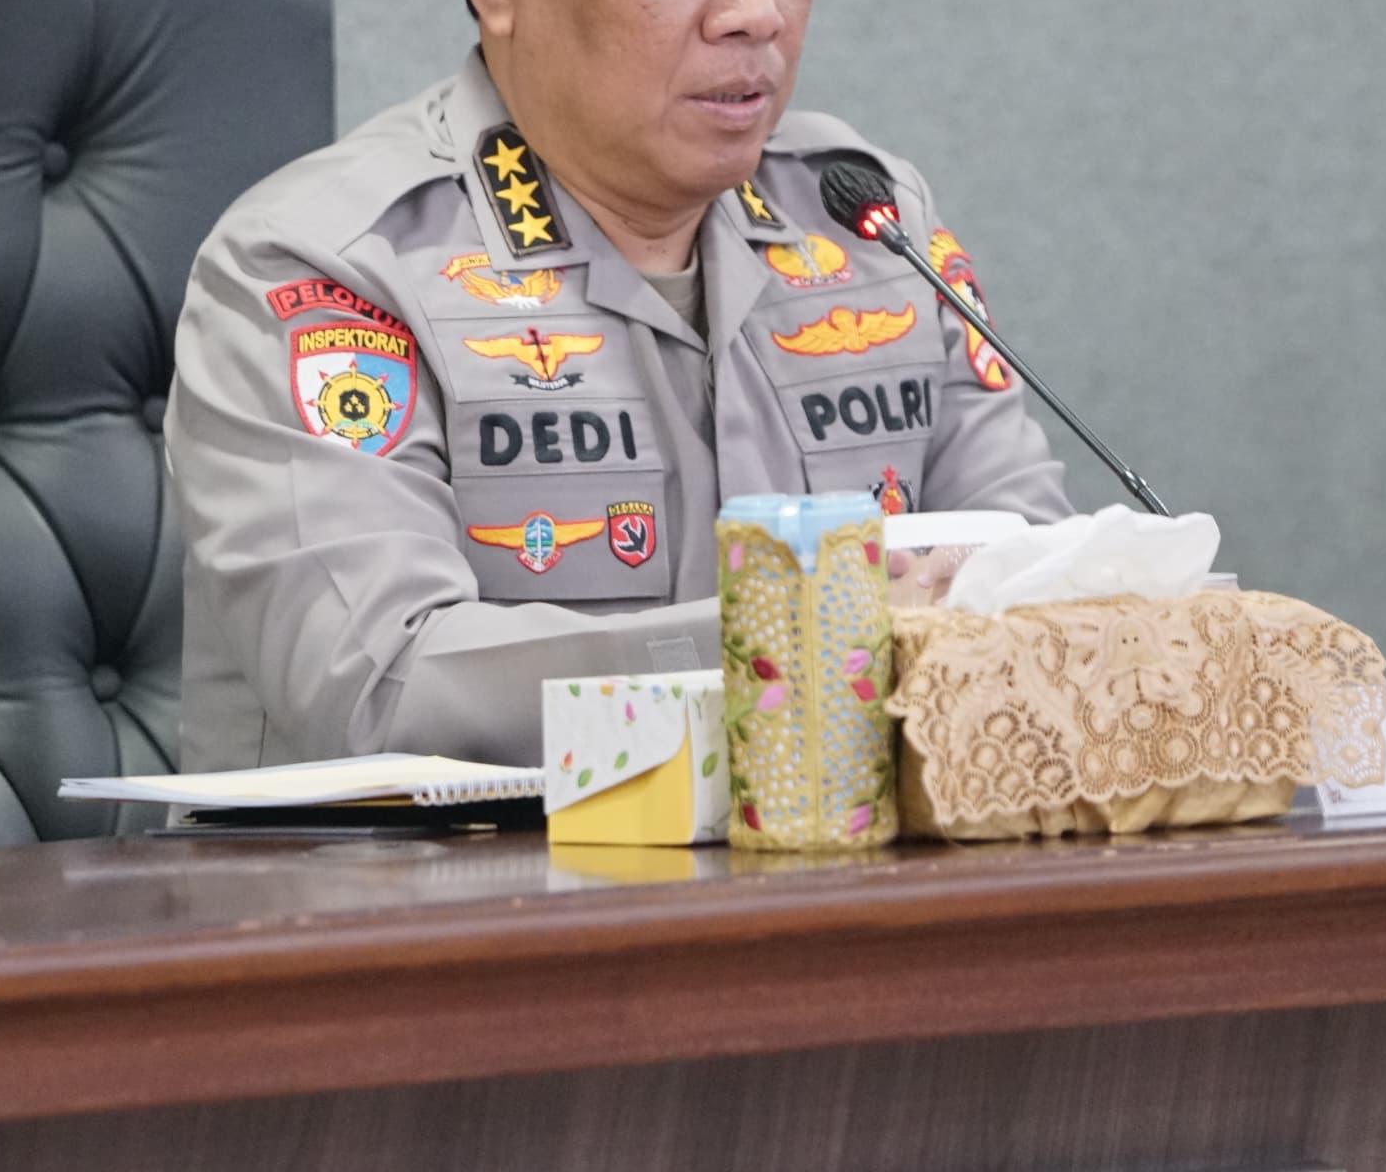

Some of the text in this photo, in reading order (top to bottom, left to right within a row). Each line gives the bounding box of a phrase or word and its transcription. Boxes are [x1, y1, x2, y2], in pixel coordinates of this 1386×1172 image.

[299, 329, 408, 357] INSPEKTORAT
[801, 378, 932, 441] POLRI
[479, 411, 637, 466] DEDI
